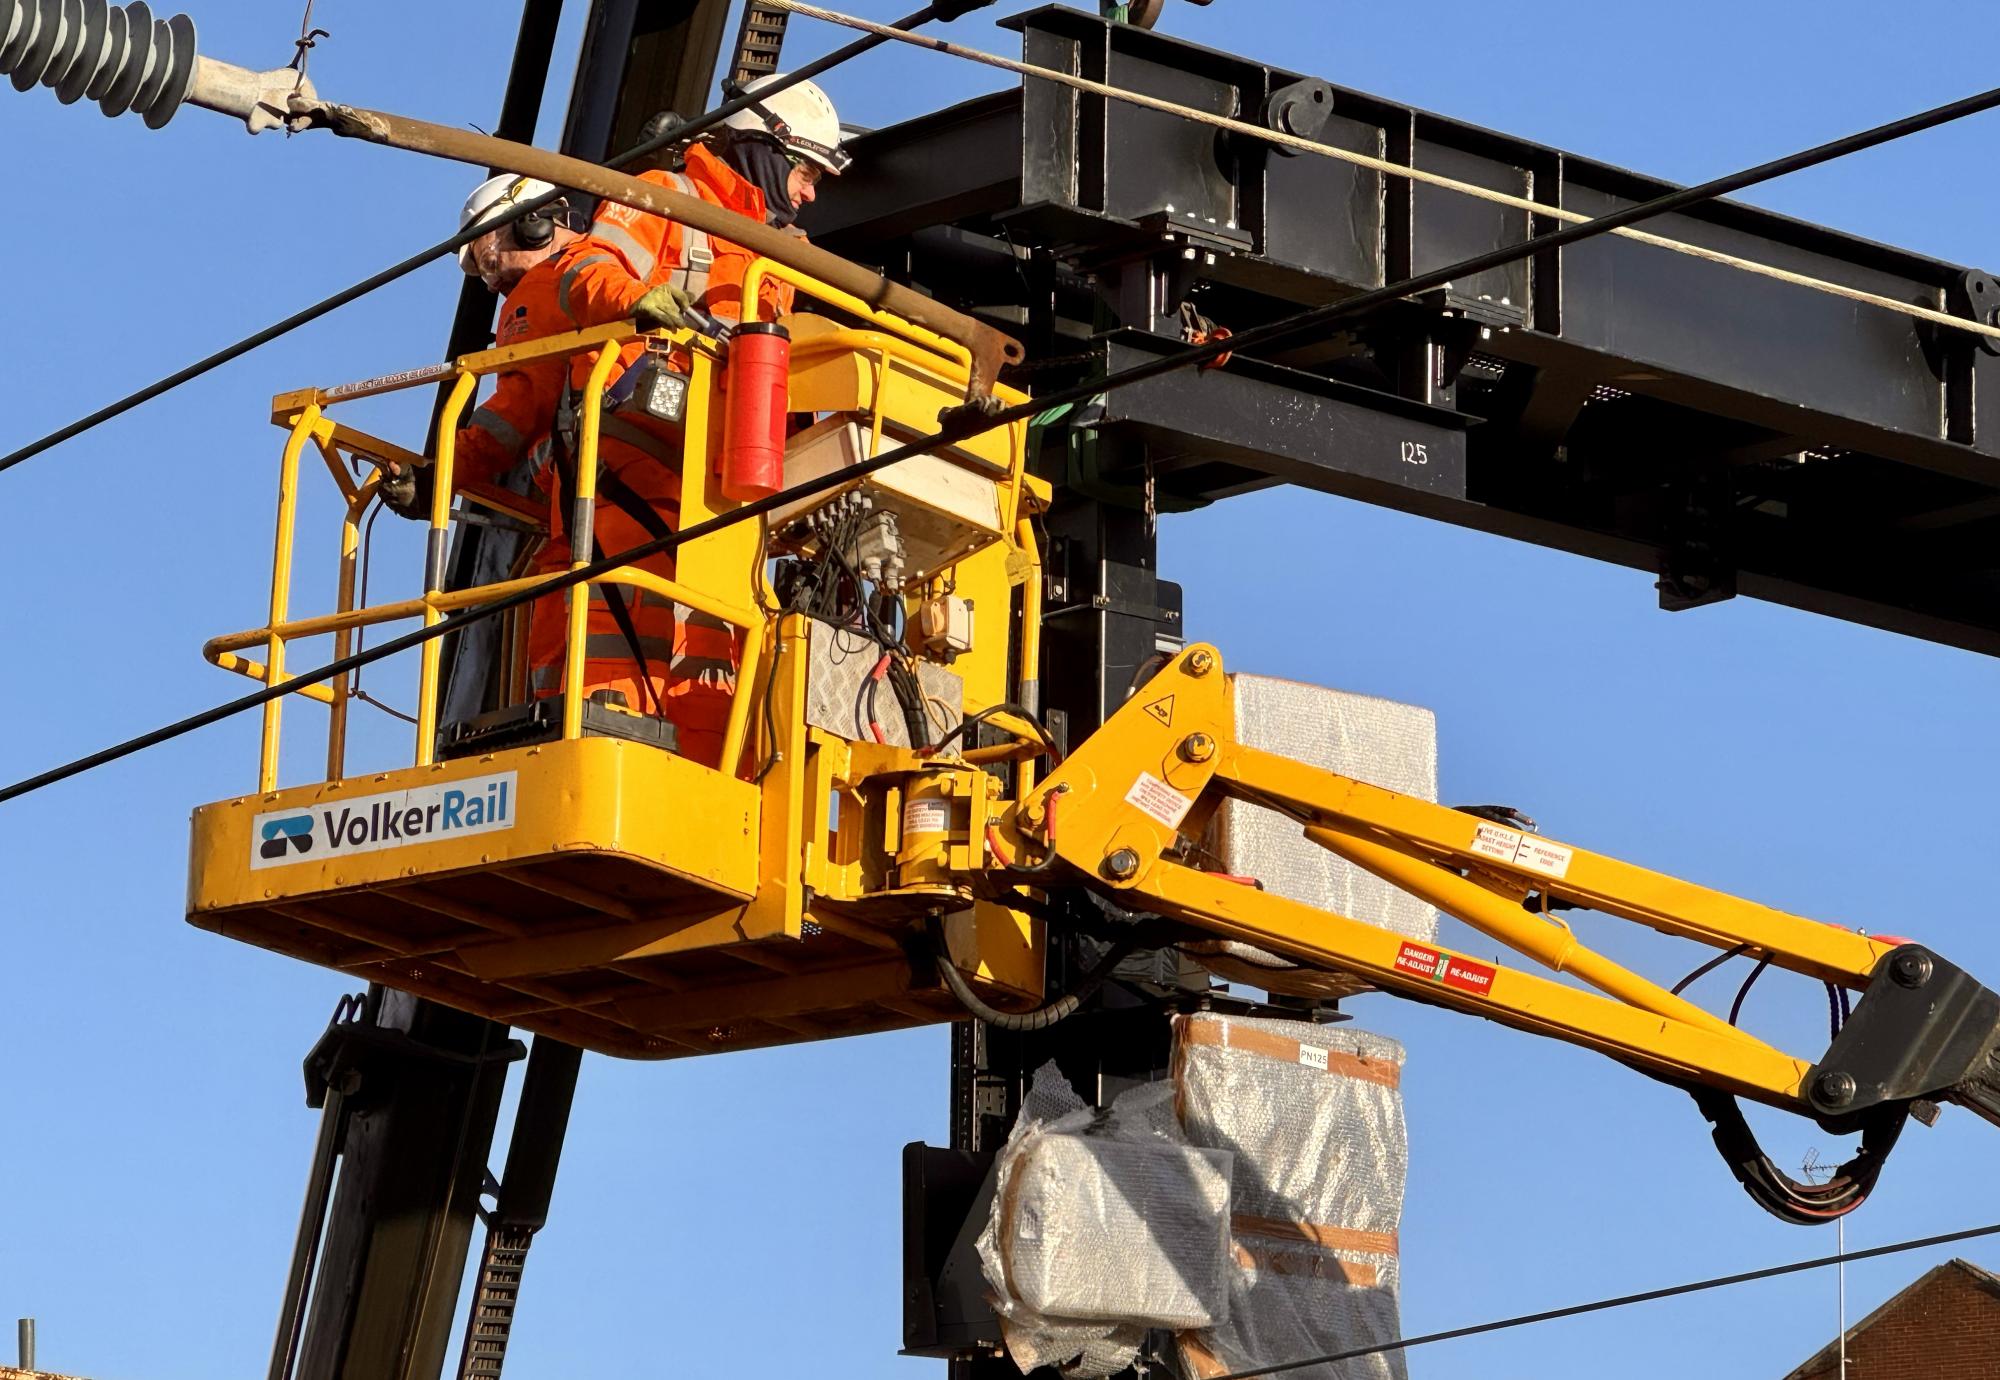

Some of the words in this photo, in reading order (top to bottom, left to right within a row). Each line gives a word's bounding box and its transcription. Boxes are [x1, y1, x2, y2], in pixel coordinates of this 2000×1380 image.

[1401, 441, 1428, 465] 125
[323, 781, 508, 849] VolkerRail
[1396, 956, 1436, 975] RE-ADJUST
[1449, 967, 1490, 986] RE-ADJUST
[1300, 1050, 1327, 1064] PN125
